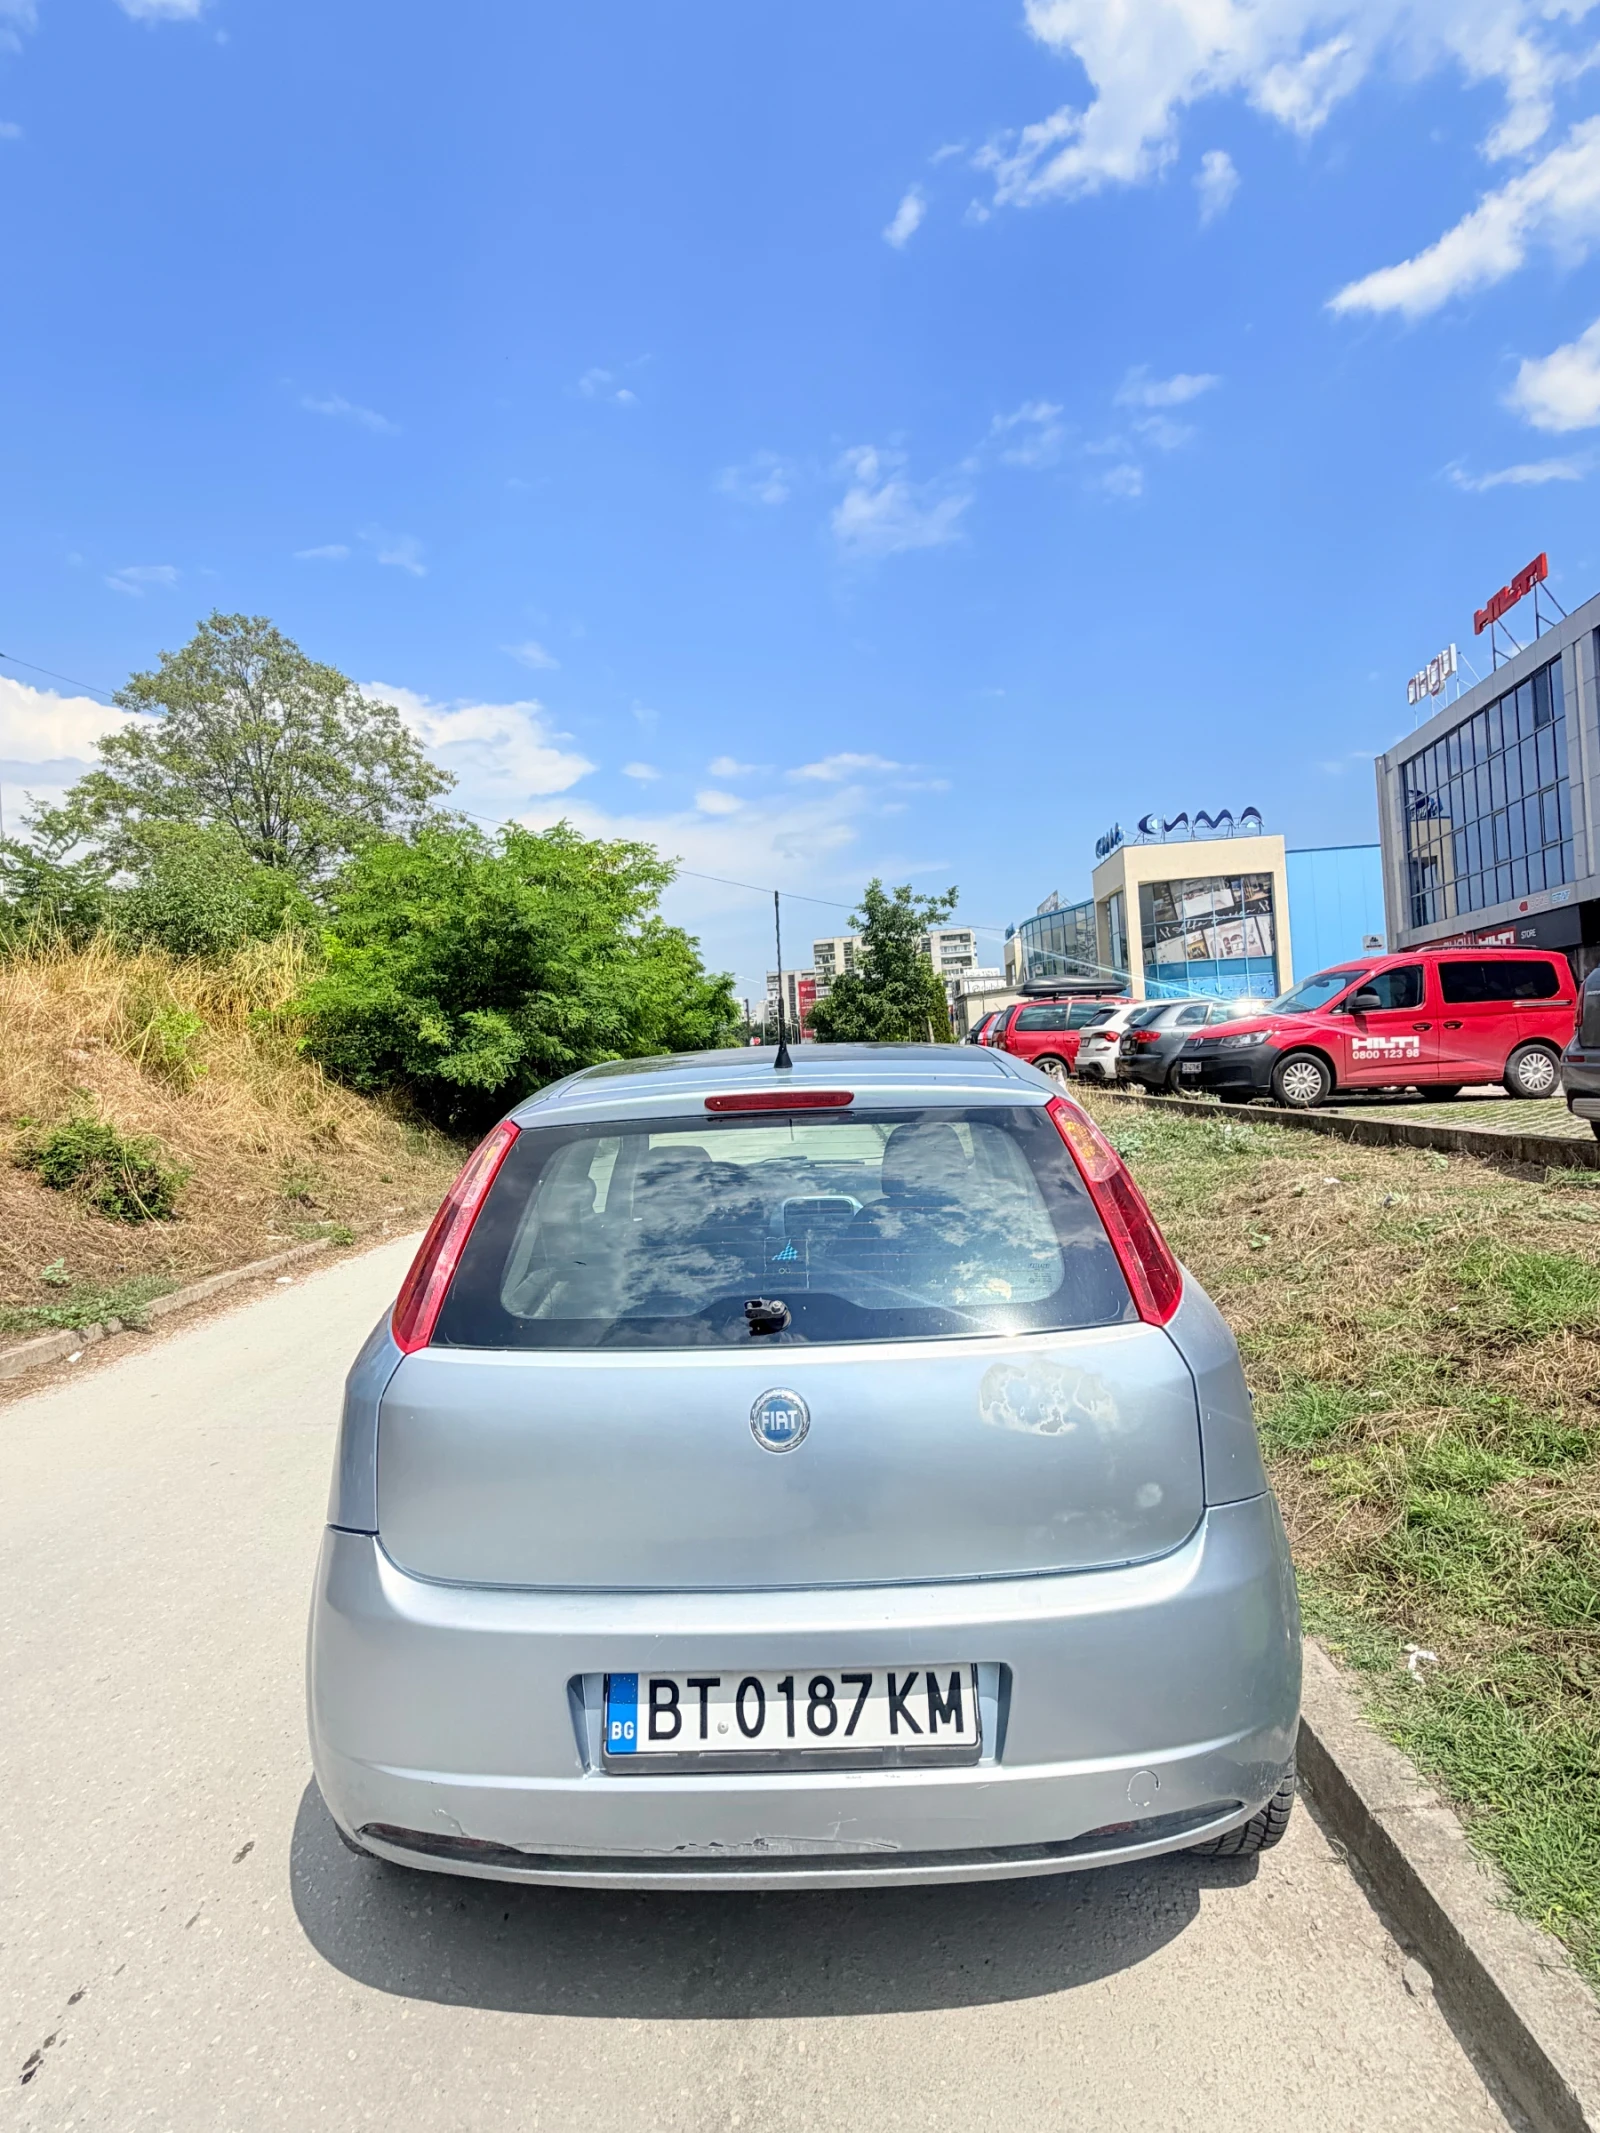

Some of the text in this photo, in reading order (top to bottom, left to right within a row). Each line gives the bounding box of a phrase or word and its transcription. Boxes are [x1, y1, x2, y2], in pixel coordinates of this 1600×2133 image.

[1520, 928, 1537, 939] STORE
[1351, 1036, 1420, 1050] HILTI
[1352, 1048, 1420, 1060] 0800 123 98
[761, 1410, 798, 1431] FIAT
[649, 1671, 965, 1741] BT 0187 KM
[611, 1721, 635, 1740] BG
